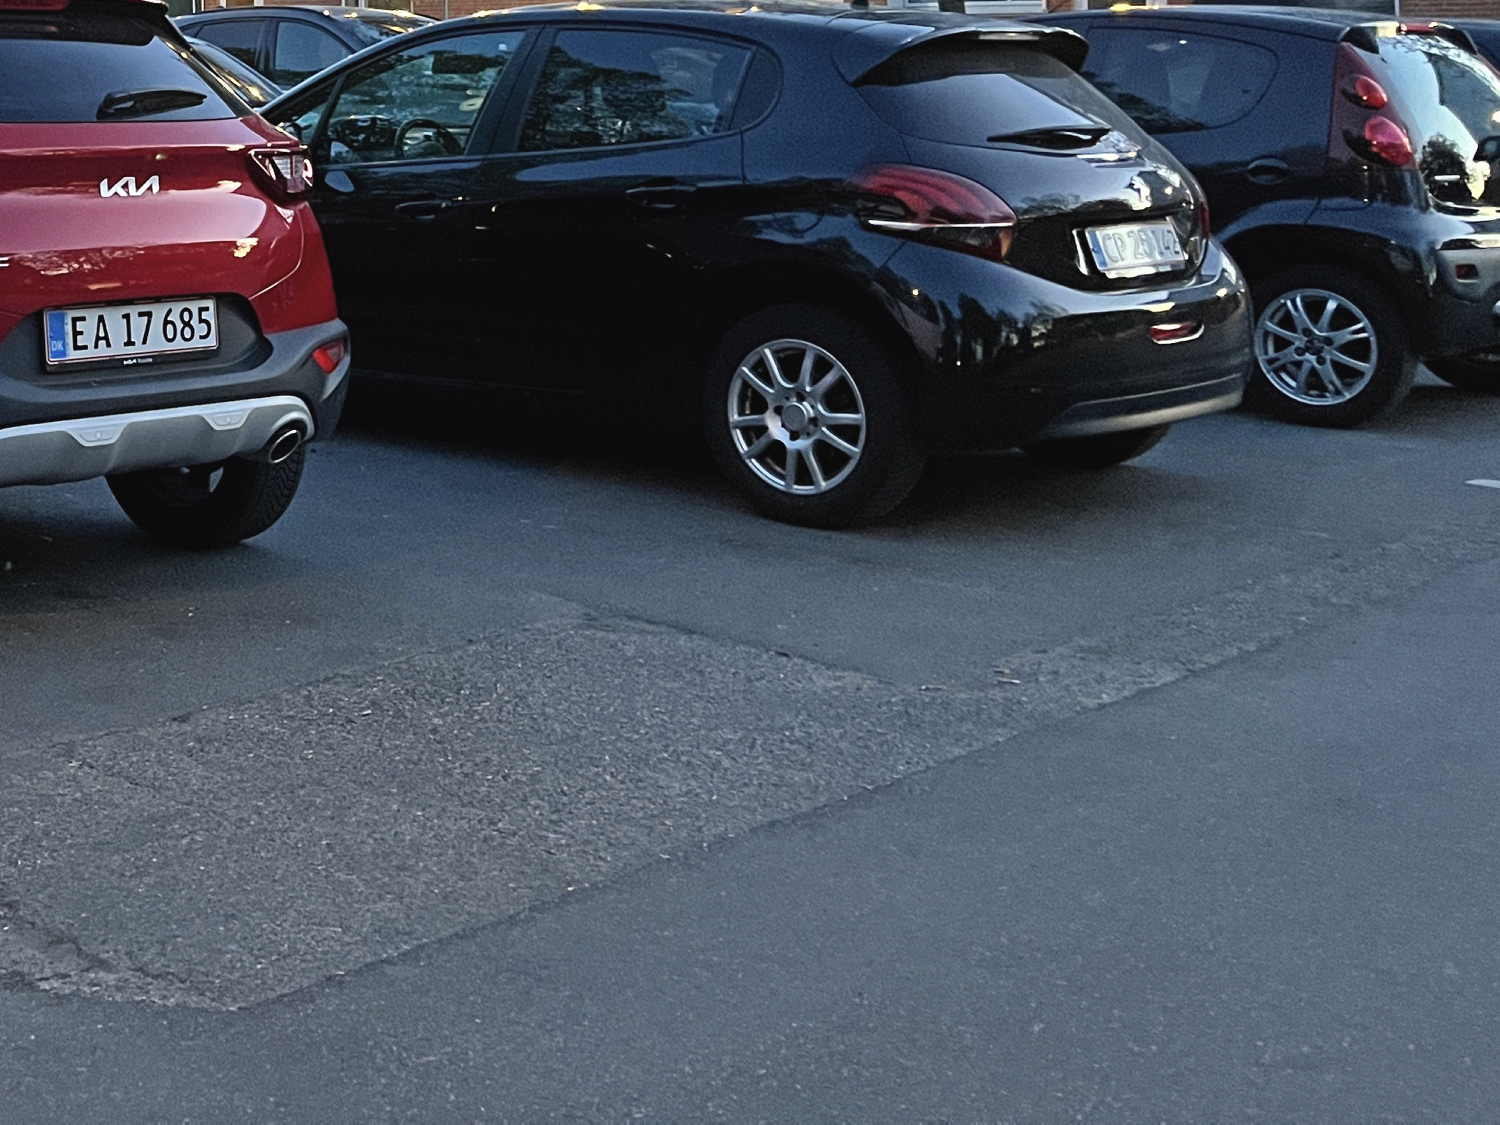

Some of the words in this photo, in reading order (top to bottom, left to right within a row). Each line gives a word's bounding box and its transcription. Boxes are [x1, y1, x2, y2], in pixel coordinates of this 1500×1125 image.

[100, 175, 160, 198] KIA
[71, 314, 112, 351] EA
[122, 311, 153, 347] 17
[162, 306, 212, 343] 685
[51, 340, 64, 352] DK
